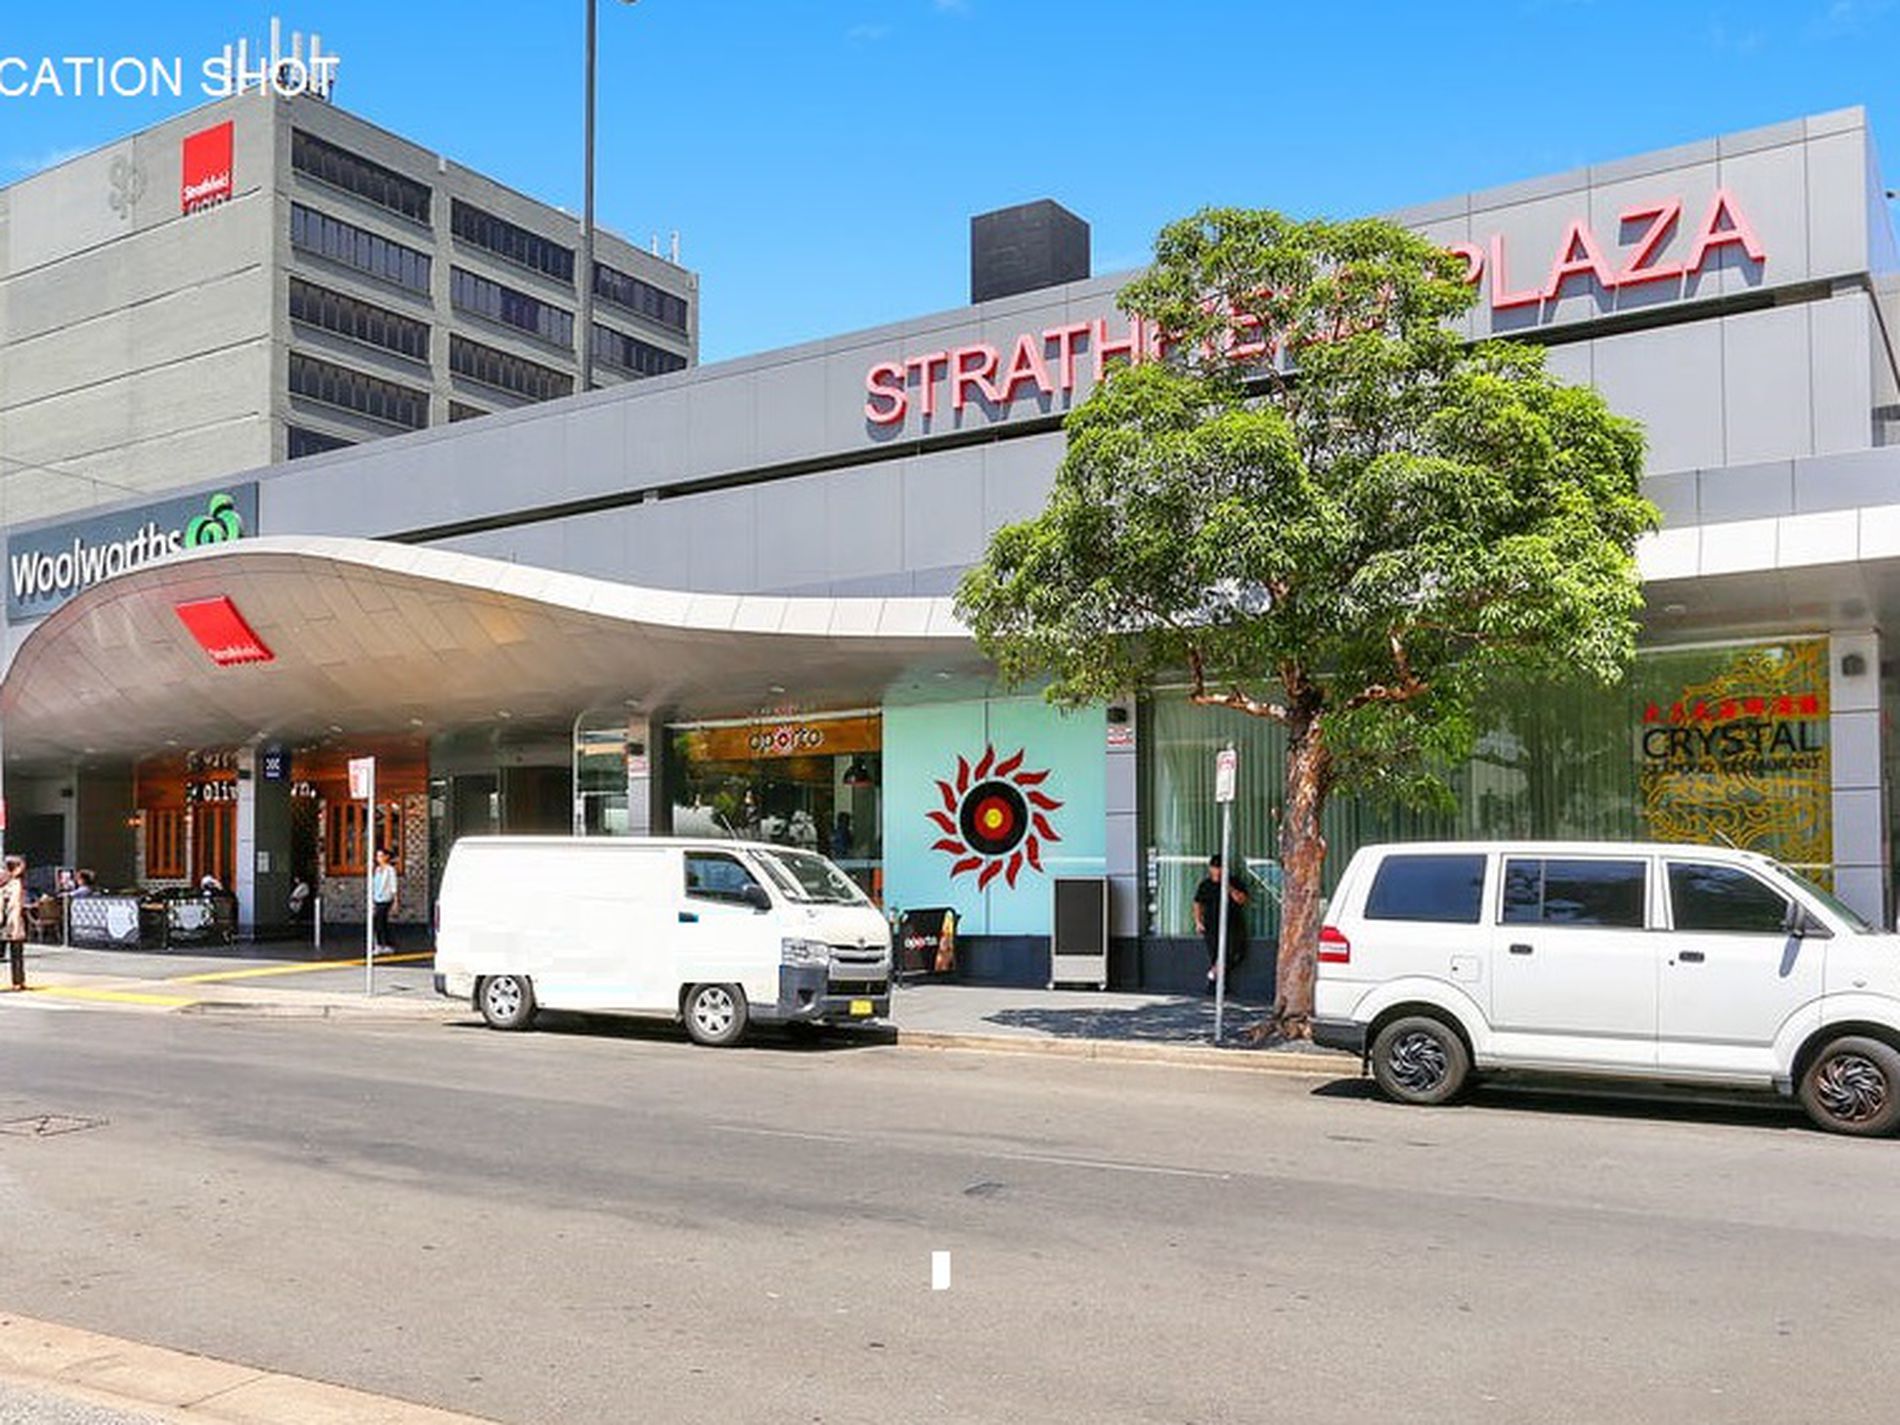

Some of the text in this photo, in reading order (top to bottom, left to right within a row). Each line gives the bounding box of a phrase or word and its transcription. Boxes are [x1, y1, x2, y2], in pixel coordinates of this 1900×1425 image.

[866, 266, 1395, 425] STRATHE
[12, 521, 183, 597] Woolworths
[1642, 720, 1821, 758] CRYSTAL
